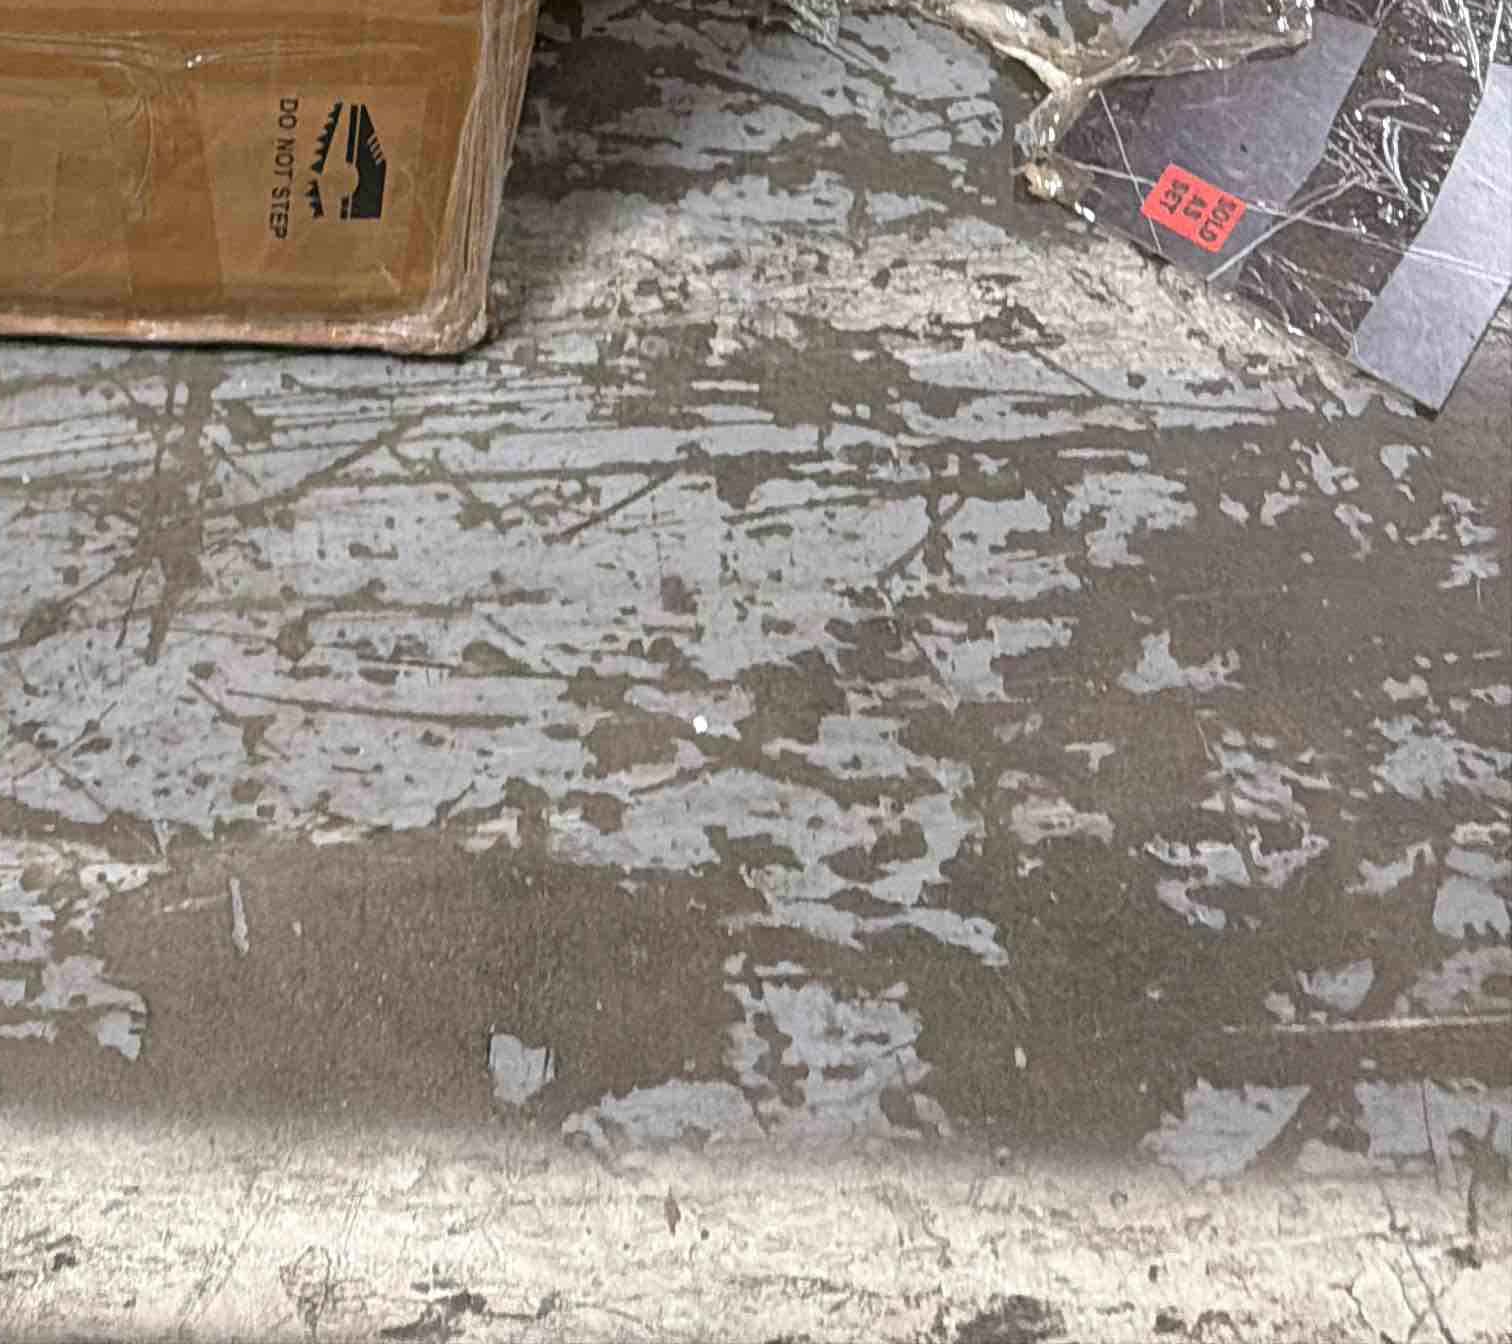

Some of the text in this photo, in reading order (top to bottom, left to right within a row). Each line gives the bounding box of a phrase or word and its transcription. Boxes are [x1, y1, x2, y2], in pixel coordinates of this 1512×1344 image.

[269, 98, 299, 240] DO NOT STEP
